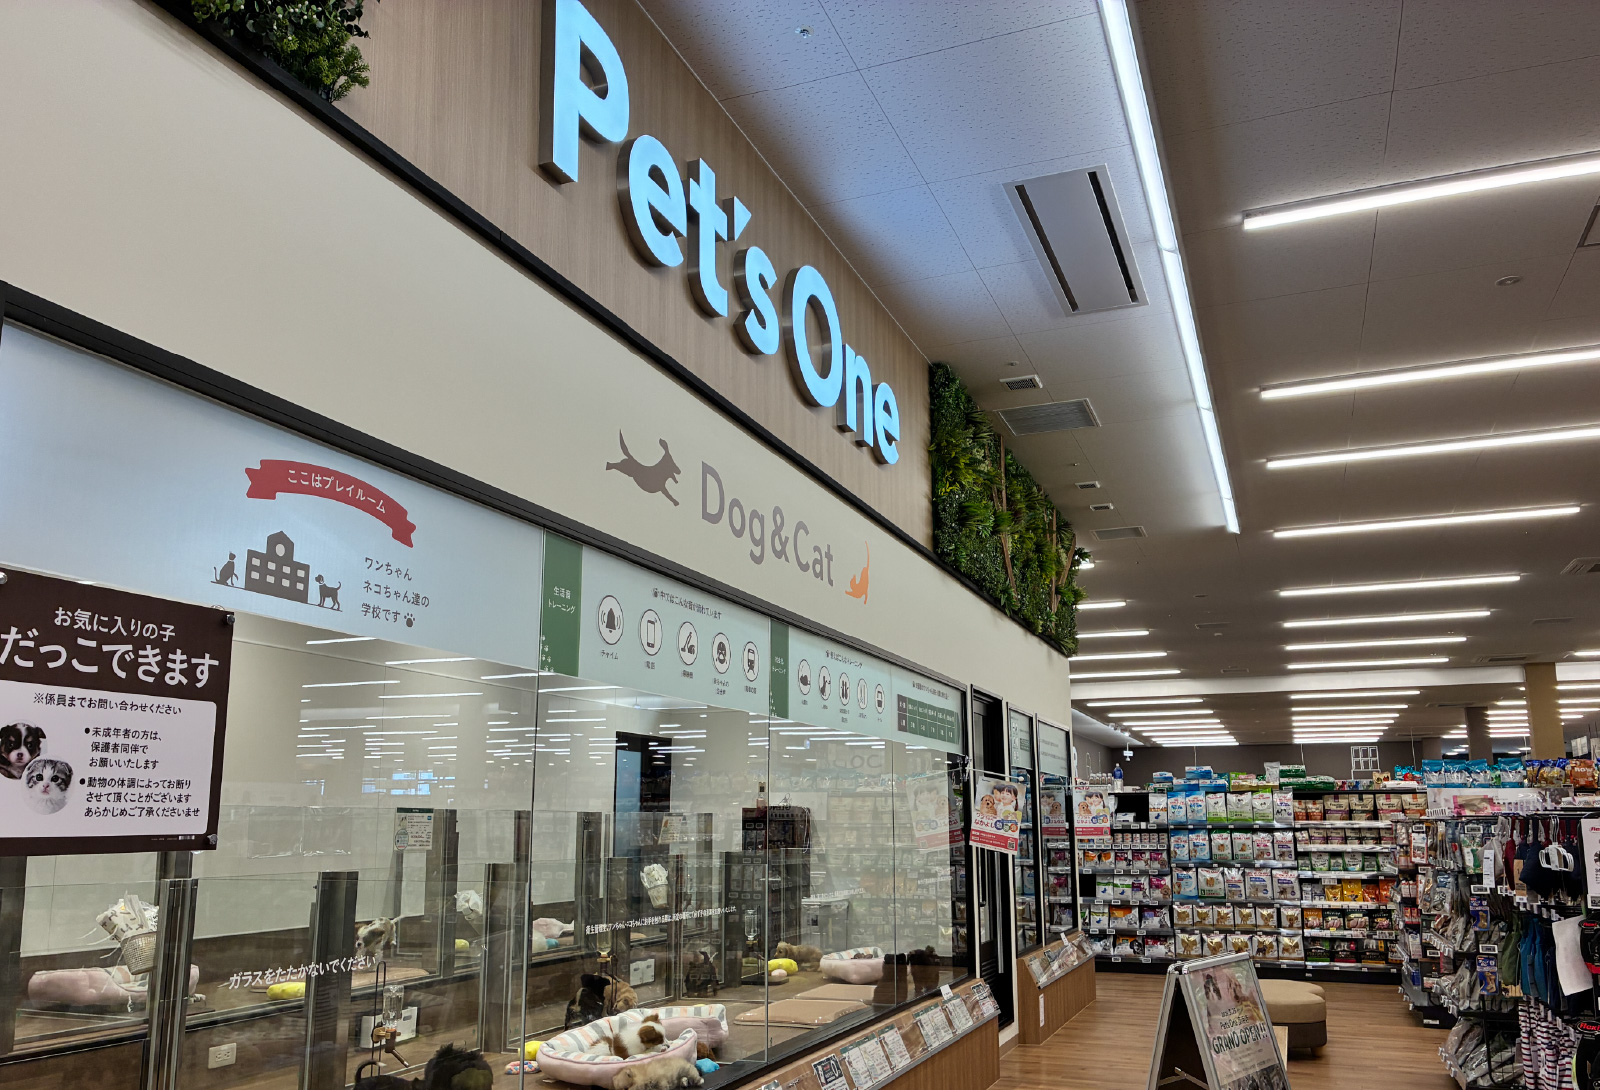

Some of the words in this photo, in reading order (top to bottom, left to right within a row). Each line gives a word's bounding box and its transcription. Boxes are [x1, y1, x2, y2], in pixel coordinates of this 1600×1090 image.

[288, 469, 386, 514] ここはプレイルーム
[701, 460, 834, 587] Dog&Cat
[365, 557, 412, 581] ワンちゃん
[363, 580, 430, 608] ネコちゃん達の
[361, 602, 401, 623] 学校です
[548, 598, 576, 614] トレーニング
[54, 607, 176, 642] お気に入りの子
[0, 626, 219, 688] だっこできます
[33, 692, 182, 715] ※係員までお問い合わせください
[90, 741, 149, 755] 保護者同伴で
[88, 757, 159, 770] お願いいたします
[86, 776, 191, 790] 動物の体調によってお断り
[86, 791, 192, 804] させて頂くことがございます
[84, 806, 200, 818] あらかじめご了承くださいませ
[228, 953, 378, 990] ガラスをたたかないでください
[1212, 1031, 1240, 1055] GRAND
